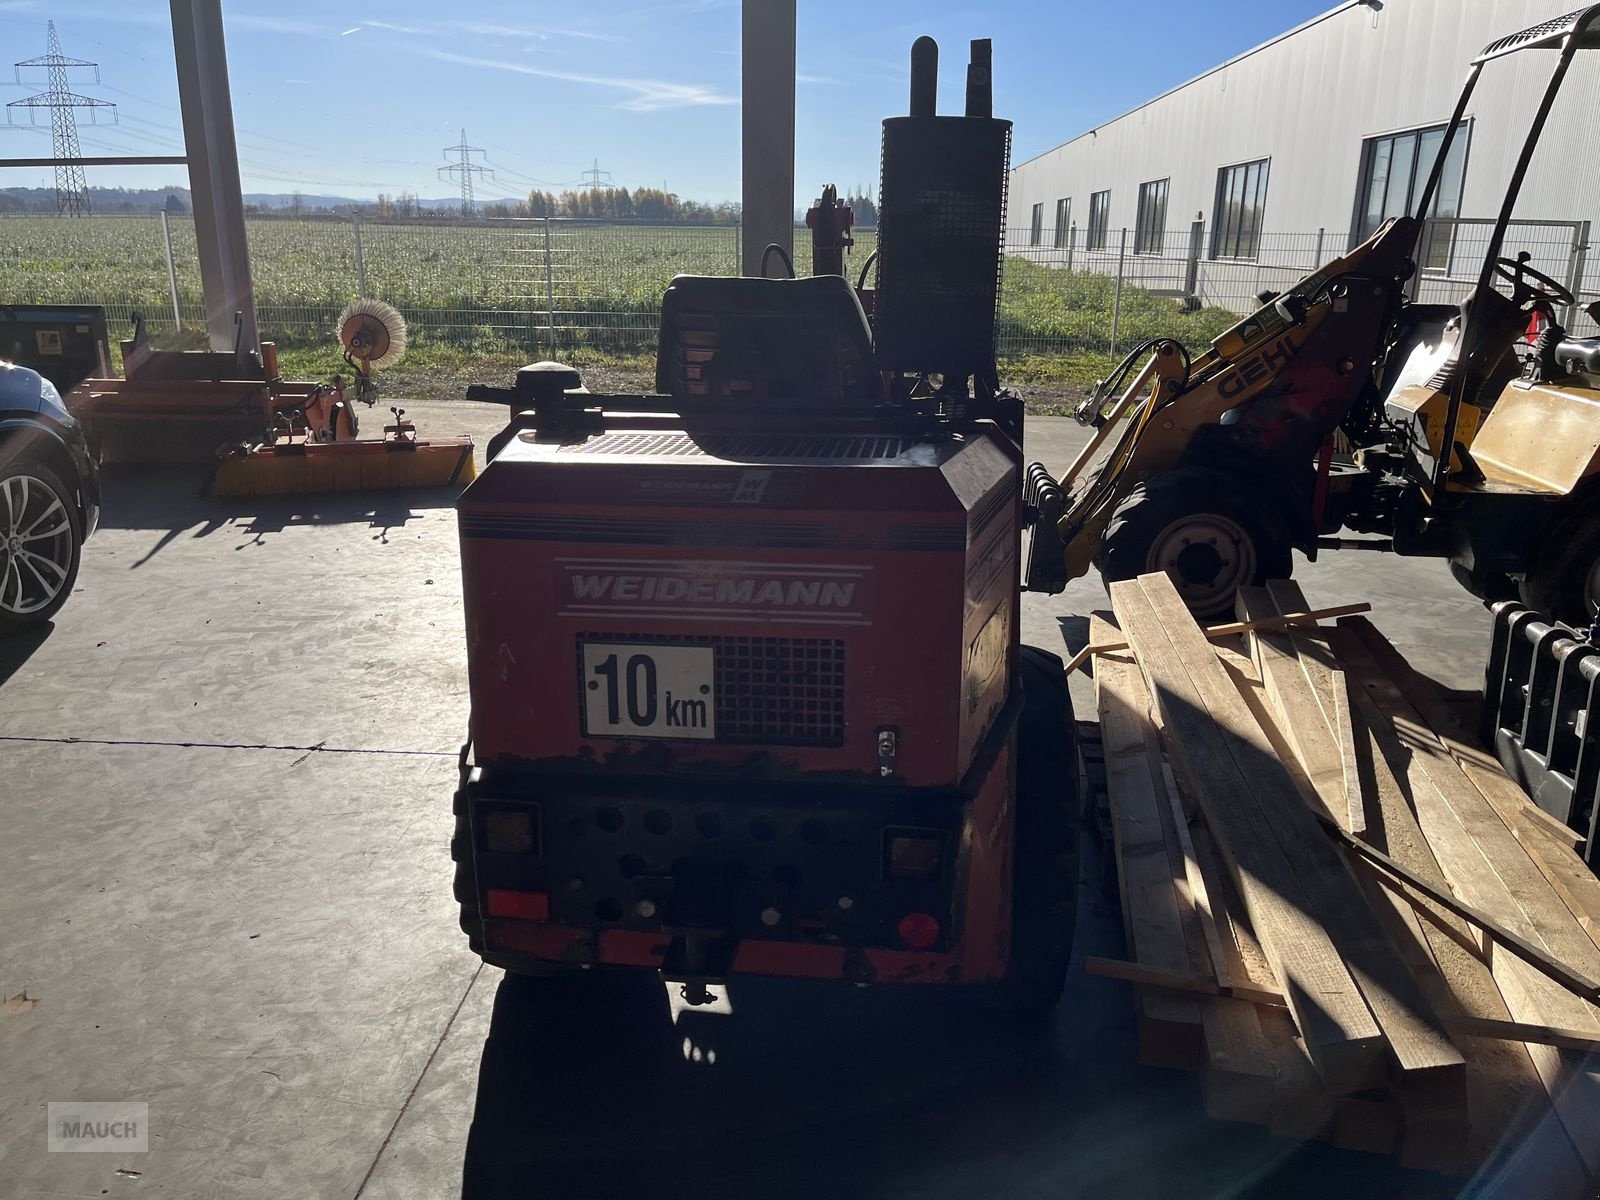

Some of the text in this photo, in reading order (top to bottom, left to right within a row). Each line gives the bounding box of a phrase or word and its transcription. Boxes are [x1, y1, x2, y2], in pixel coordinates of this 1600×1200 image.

[570, 575, 856, 606] WEIDEMANN
[594, 653, 707, 728] 10 km
